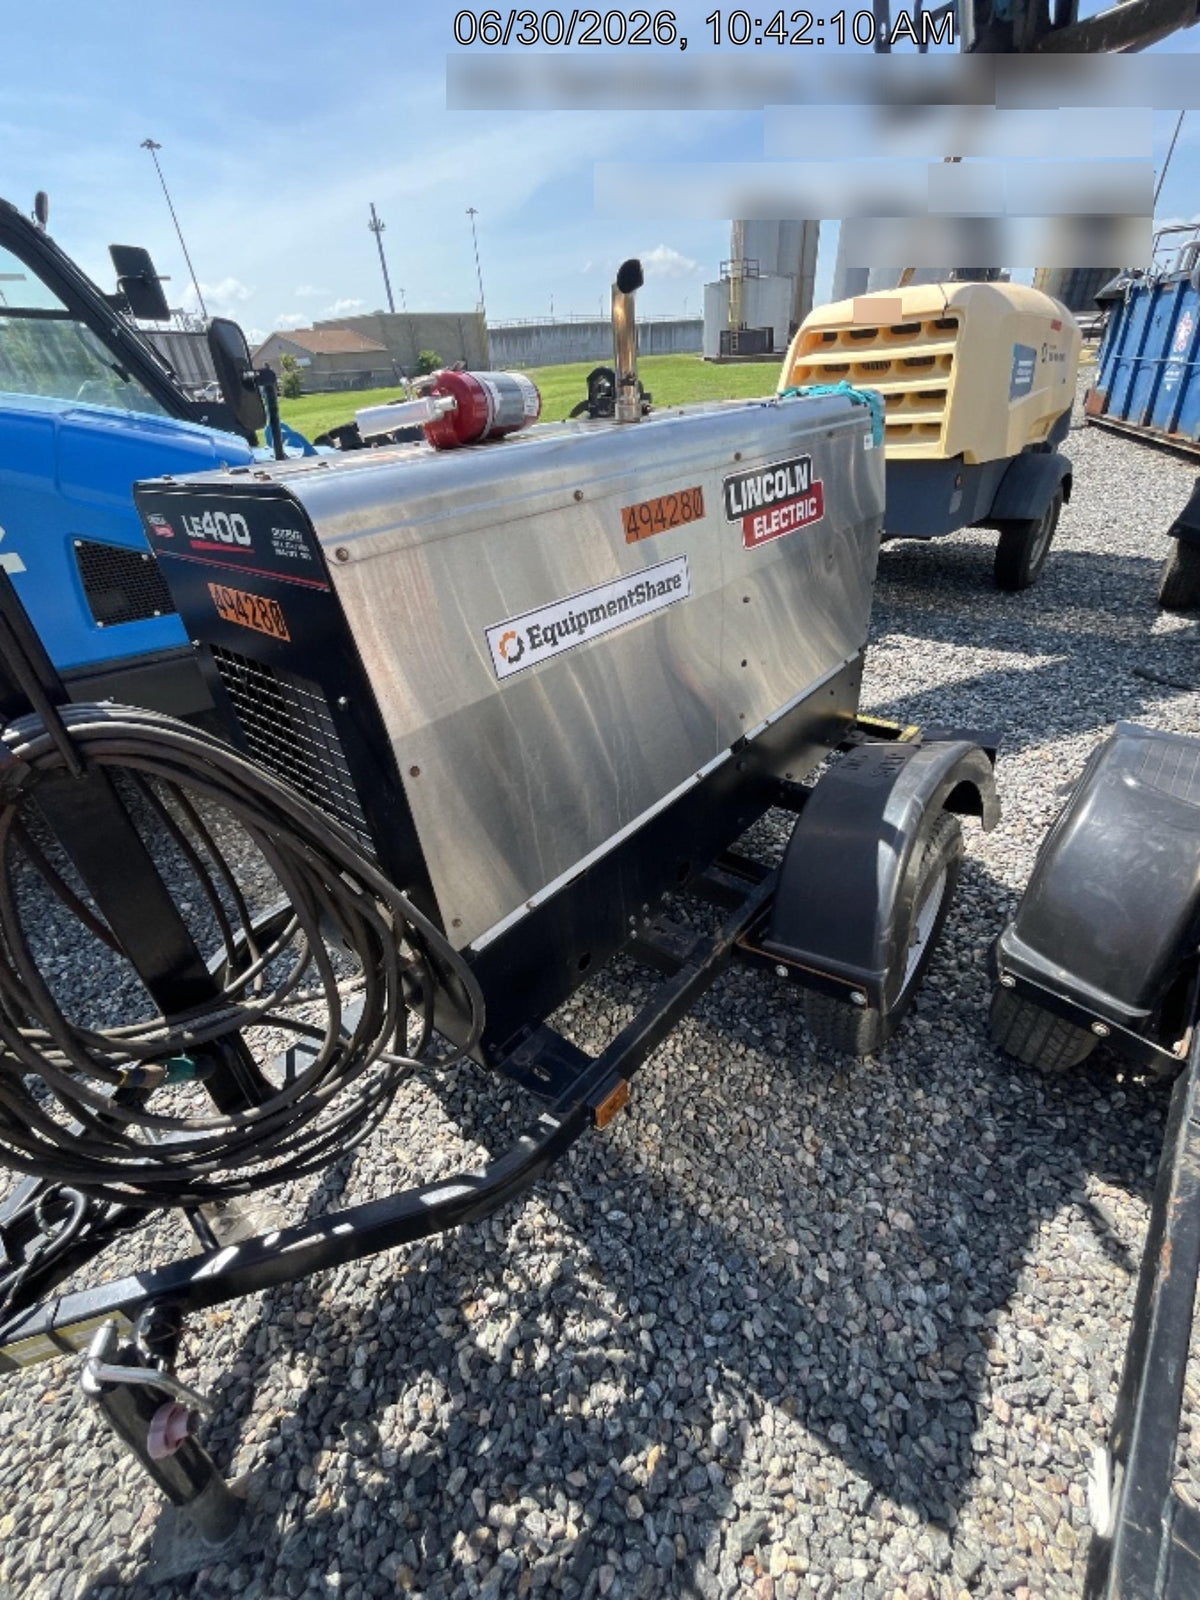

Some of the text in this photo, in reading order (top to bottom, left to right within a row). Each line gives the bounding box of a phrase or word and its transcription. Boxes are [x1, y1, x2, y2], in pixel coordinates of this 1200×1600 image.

[625, 488, 704, 540] 494280
[729, 462, 809, 515] LINCOLN
[180, 511, 252, 546] LE400
[753, 497, 818, 540] ELECTRIC
[213, 585, 287, 638] 494280
[526, 573, 684, 651] EquipmentShare
